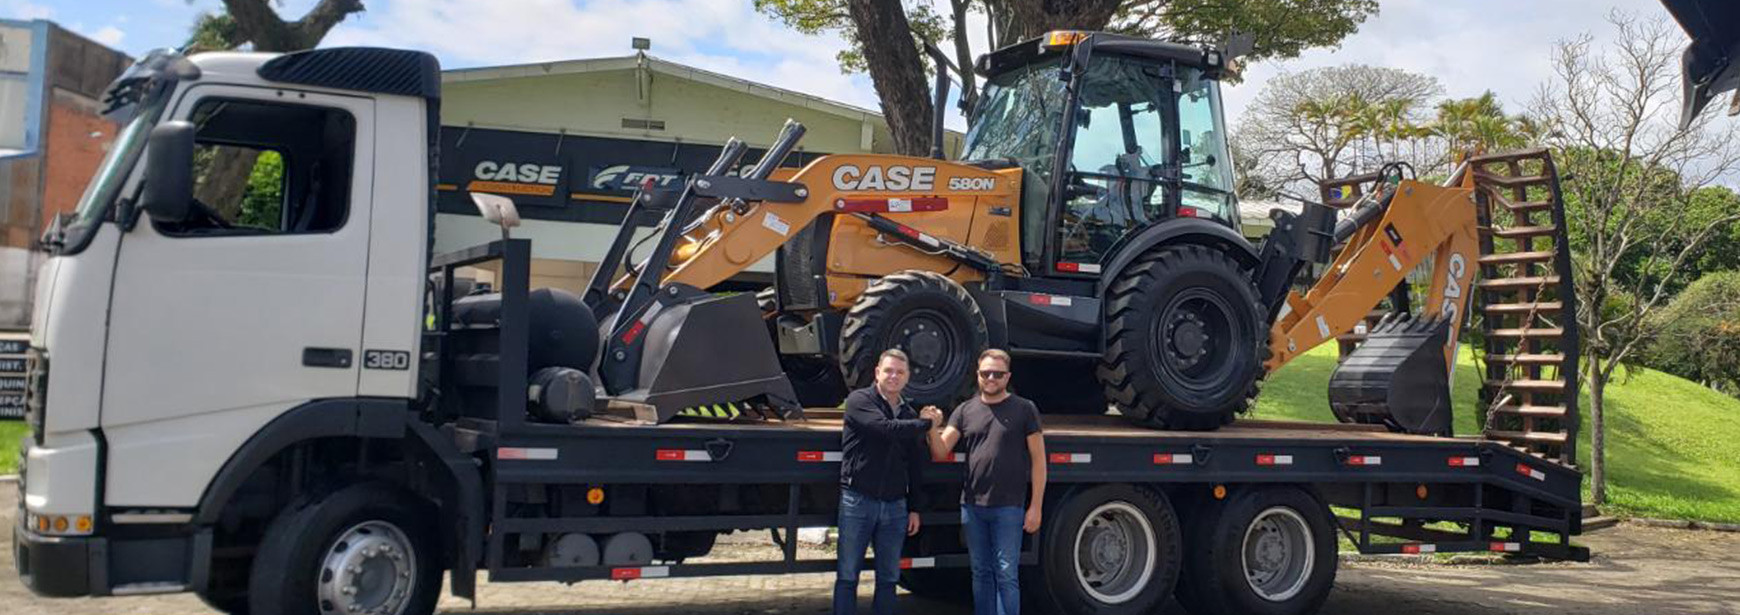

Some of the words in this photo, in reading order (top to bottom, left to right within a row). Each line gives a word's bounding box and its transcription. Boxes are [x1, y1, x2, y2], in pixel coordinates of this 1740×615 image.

[474, 160, 562, 184] CASE
[622, 172, 678, 187] FPT
[832, 165, 936, 191] CASE
[948, 177, 995, 191] 580N
[366, 351, 408, 369] 380
